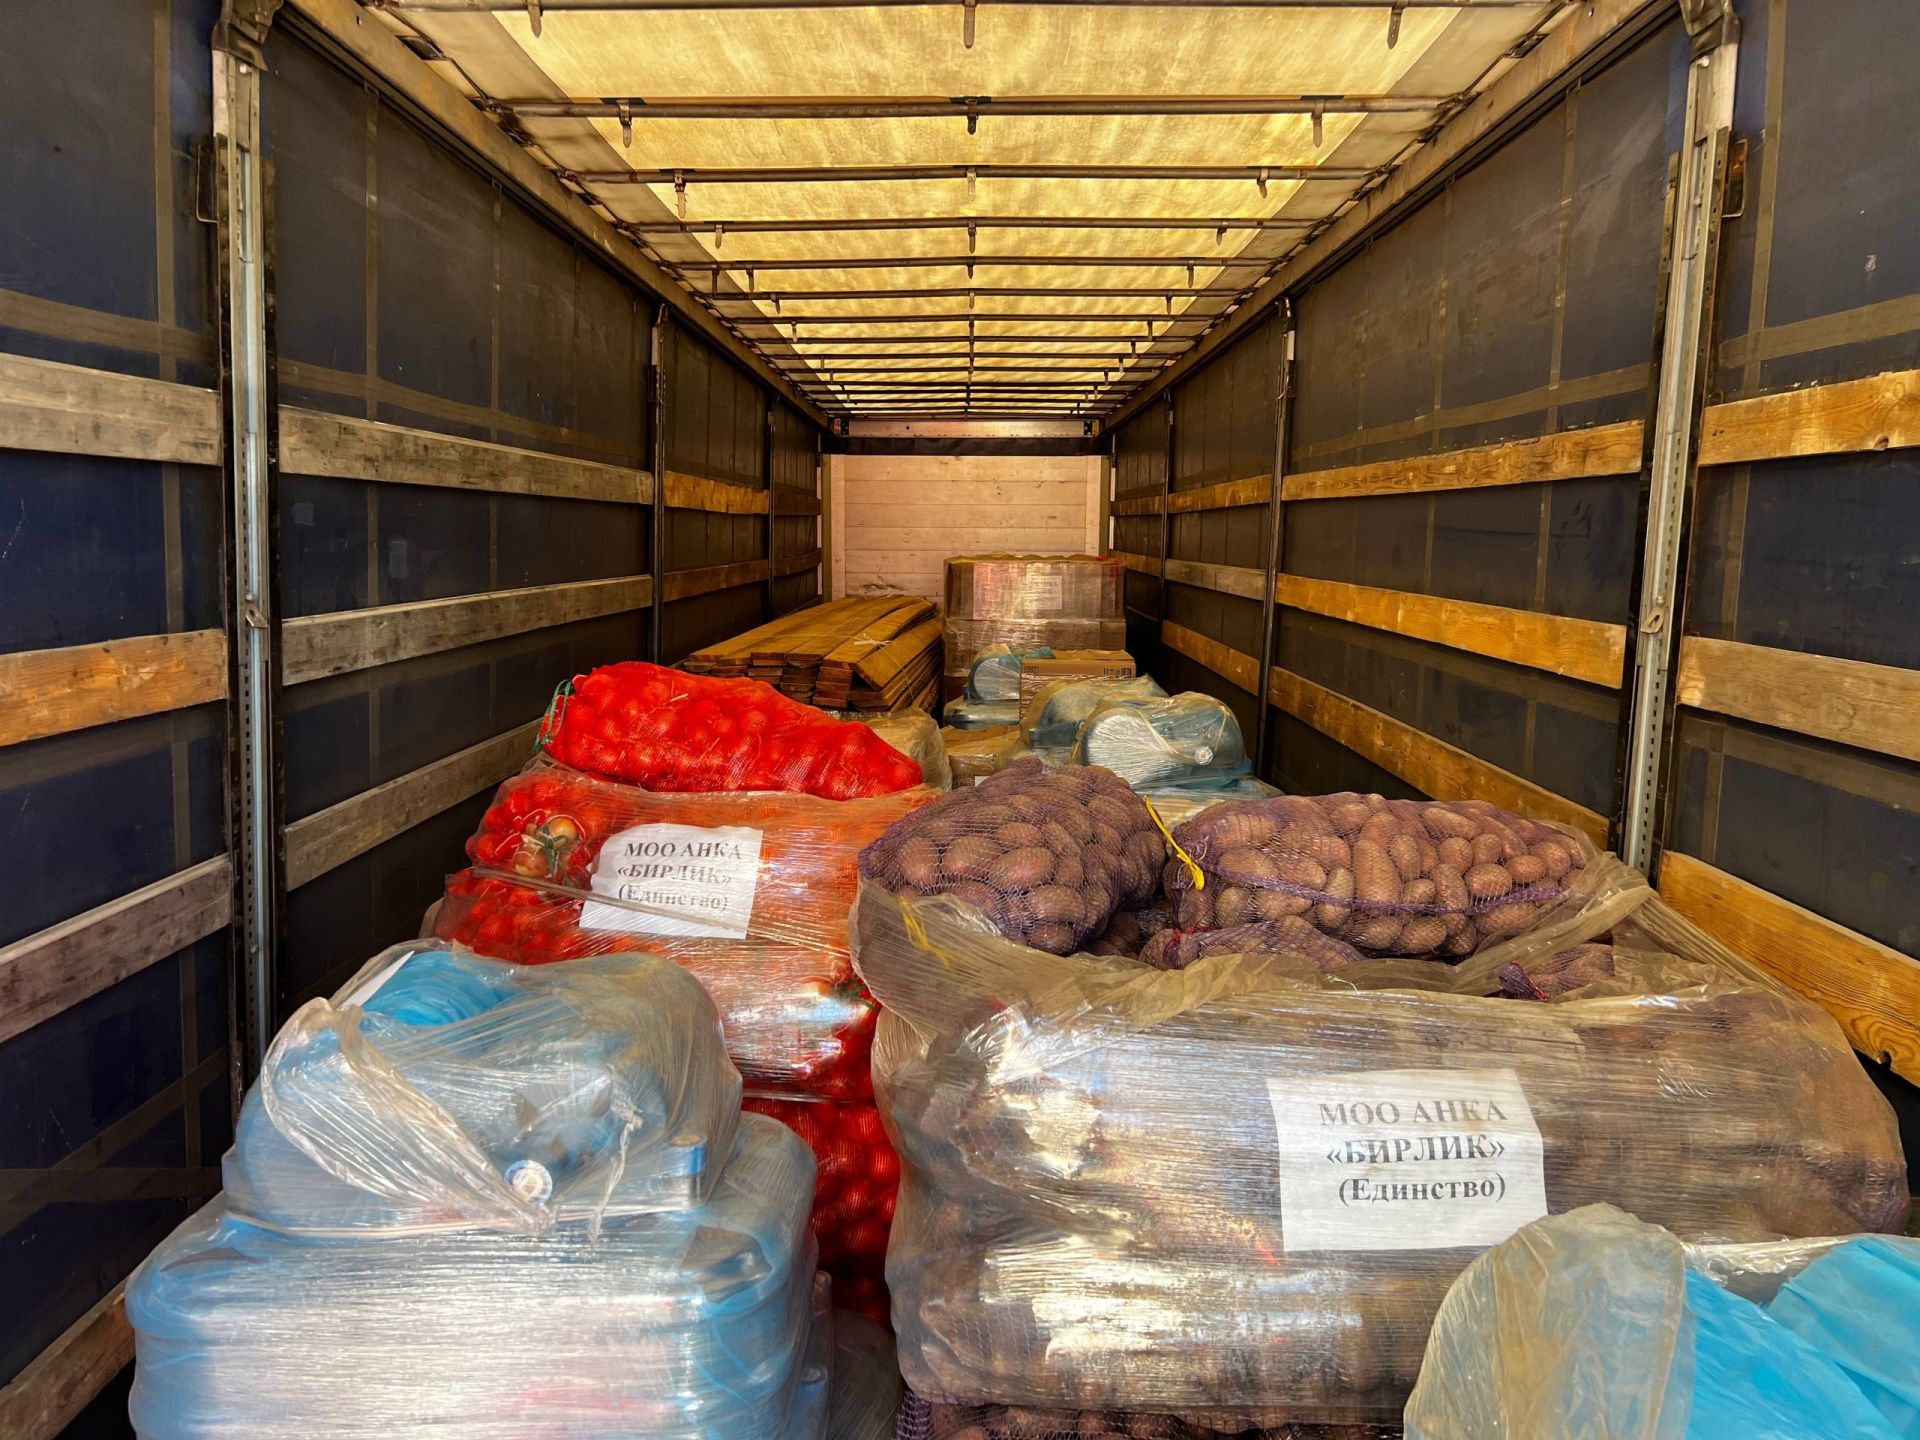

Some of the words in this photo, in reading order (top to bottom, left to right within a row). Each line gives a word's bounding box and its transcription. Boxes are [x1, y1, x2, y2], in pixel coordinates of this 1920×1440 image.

[623, 842, 676, 858] МОО
[680, 842, 742, 860] АНКА
[617, 864, 732, 885] «БИРЛИК»
[1318, 1101, 1400, 1126] МОО
[1412, 1099, 1507, 1123] АНКА
[1326, 1134, 1505, 1164] «БИРЛИК»
[1339, 1172, 1506, 1206] (Единство)
